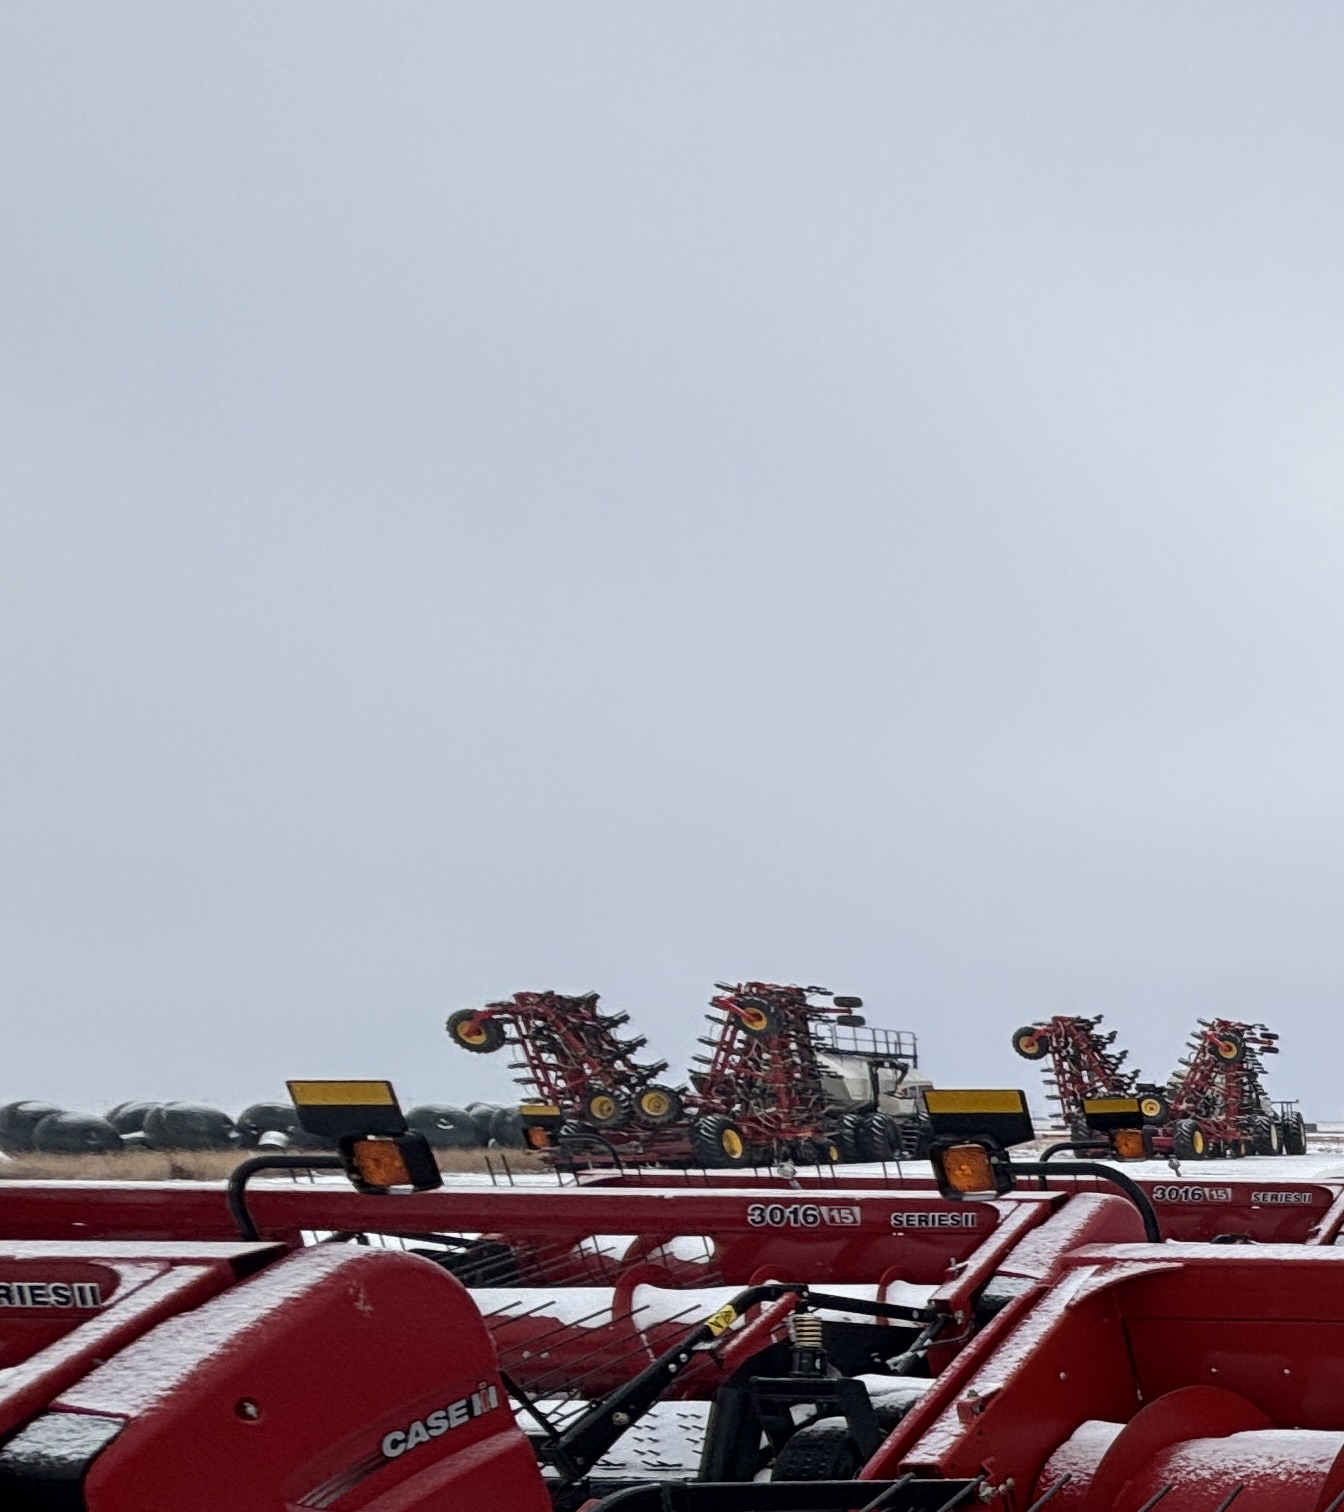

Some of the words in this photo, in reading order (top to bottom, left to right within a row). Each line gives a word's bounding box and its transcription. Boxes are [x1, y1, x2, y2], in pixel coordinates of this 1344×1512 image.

[1153, 1185, 1202, 1201] 3016
[747, 1204, 820, 1227] 3016
[382, 1399, 469, 1458] CASE
